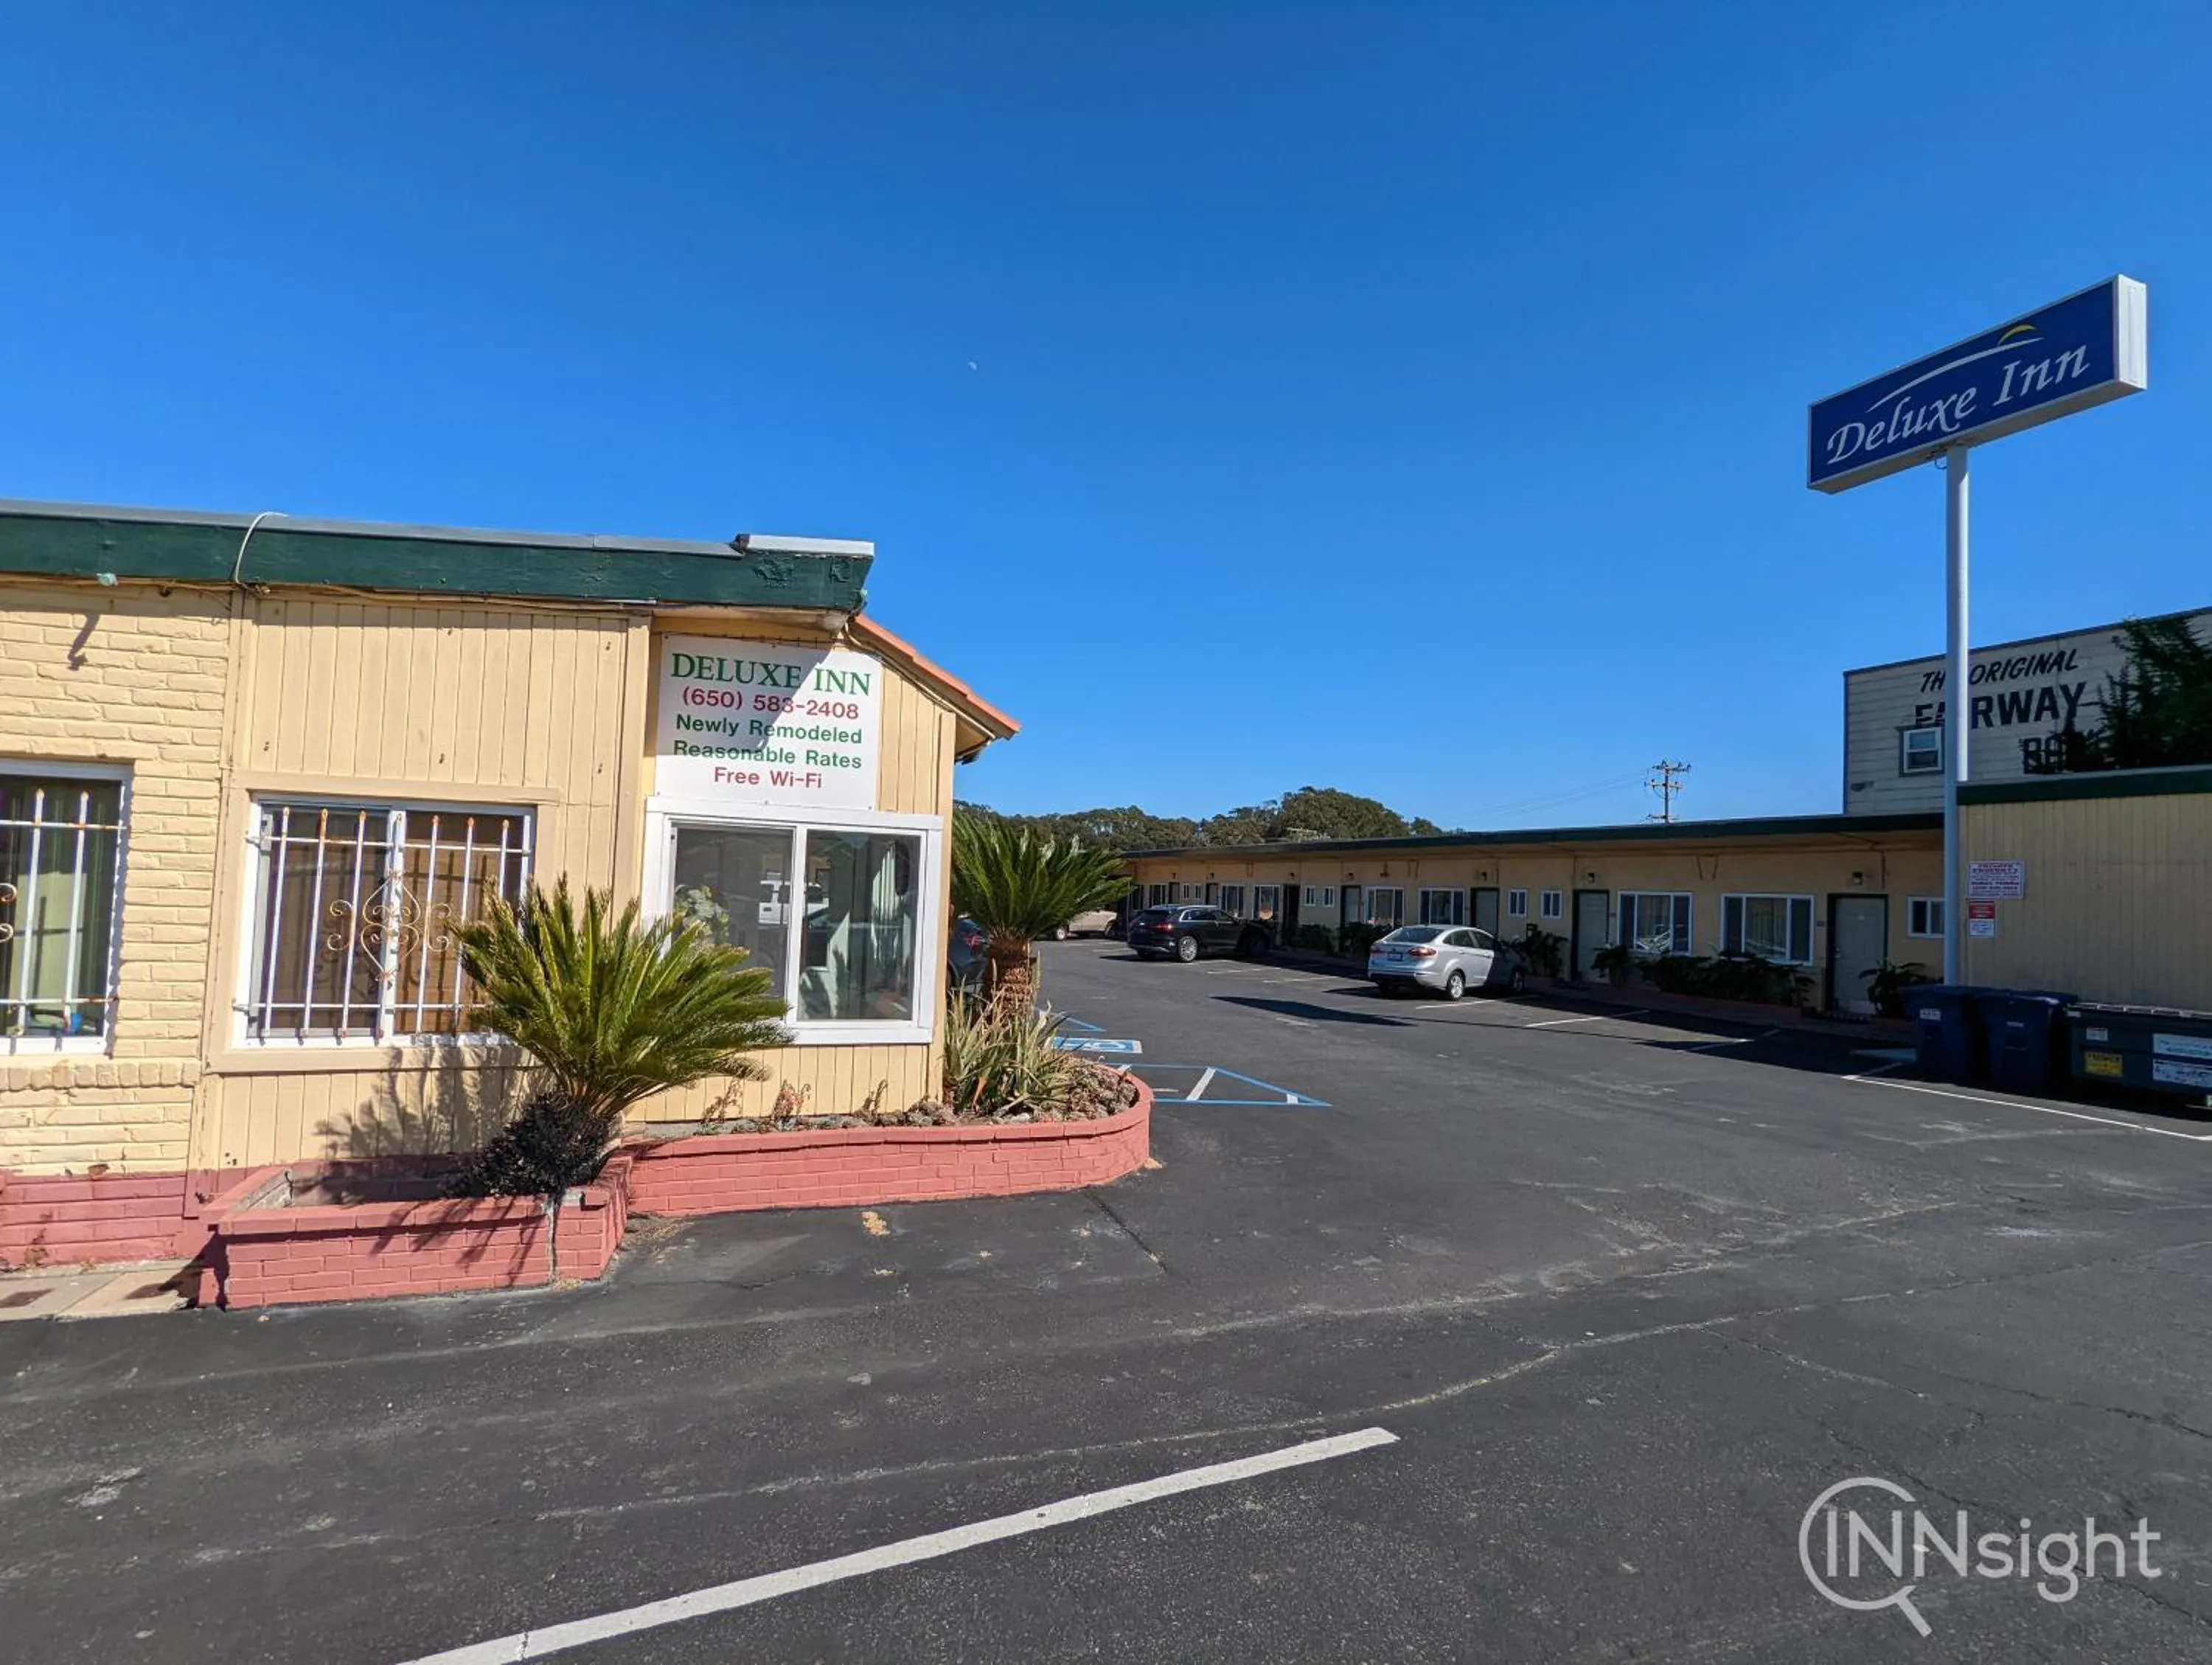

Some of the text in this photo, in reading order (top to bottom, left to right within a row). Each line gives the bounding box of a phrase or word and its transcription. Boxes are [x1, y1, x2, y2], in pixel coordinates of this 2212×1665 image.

[1827, 344, 2090, 465] Deluxe Inn
[672, 653, 872, 696] DELUXE INN
[1969, 649, 2079, 685] ORIGINAL
[682, 686, 859, 720] (650) 583-2408
[1915, 681, 2087, 729] FRWAY
[676, 713, 862, 745] Newly Remodeled
[672, 740, 862, 769] Reasonable Rates
[714, 767, 822, 789] Free Wi-Fi
